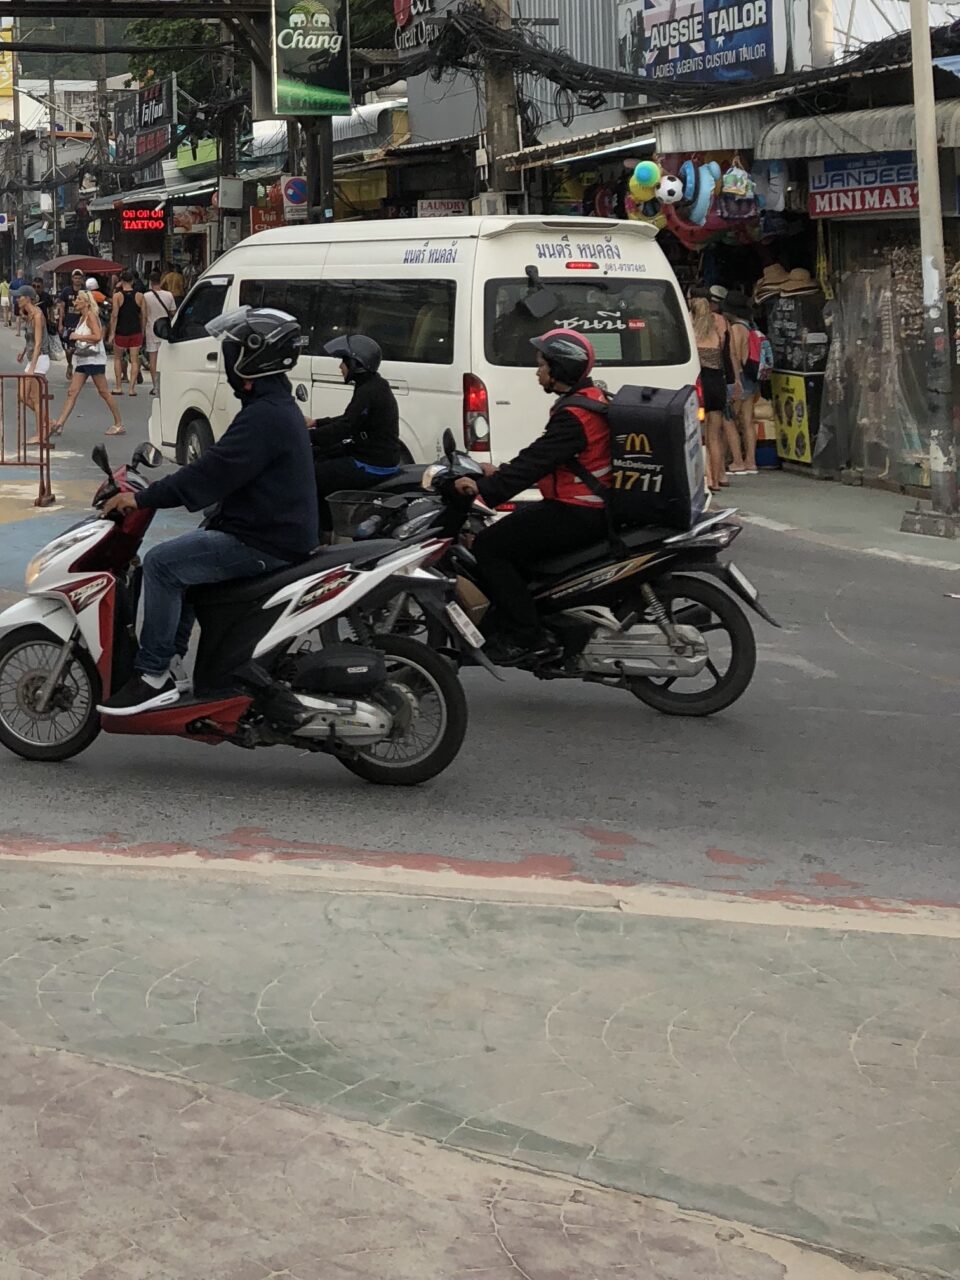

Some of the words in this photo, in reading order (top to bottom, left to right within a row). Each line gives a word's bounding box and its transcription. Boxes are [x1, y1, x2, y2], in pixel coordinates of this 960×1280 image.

[650, 15, 704, 51] AUSSIE
[708, 0, 767, 36] TAILOR
[277, 28, 343, 53] Chang
[395, 26, 417, 50] Great
[652, 62, 675, 79] LADIES
[705, 50, 736, 69] CUSTOM
[739, 43, 767, 62] TAILOR
[421, 201, 465, 210] LAUNDRY
[123, 220, 165, 229] TATTOO
[613, 459, 662, 472] McDelivery
[612, 470, 663, 493] 1711
